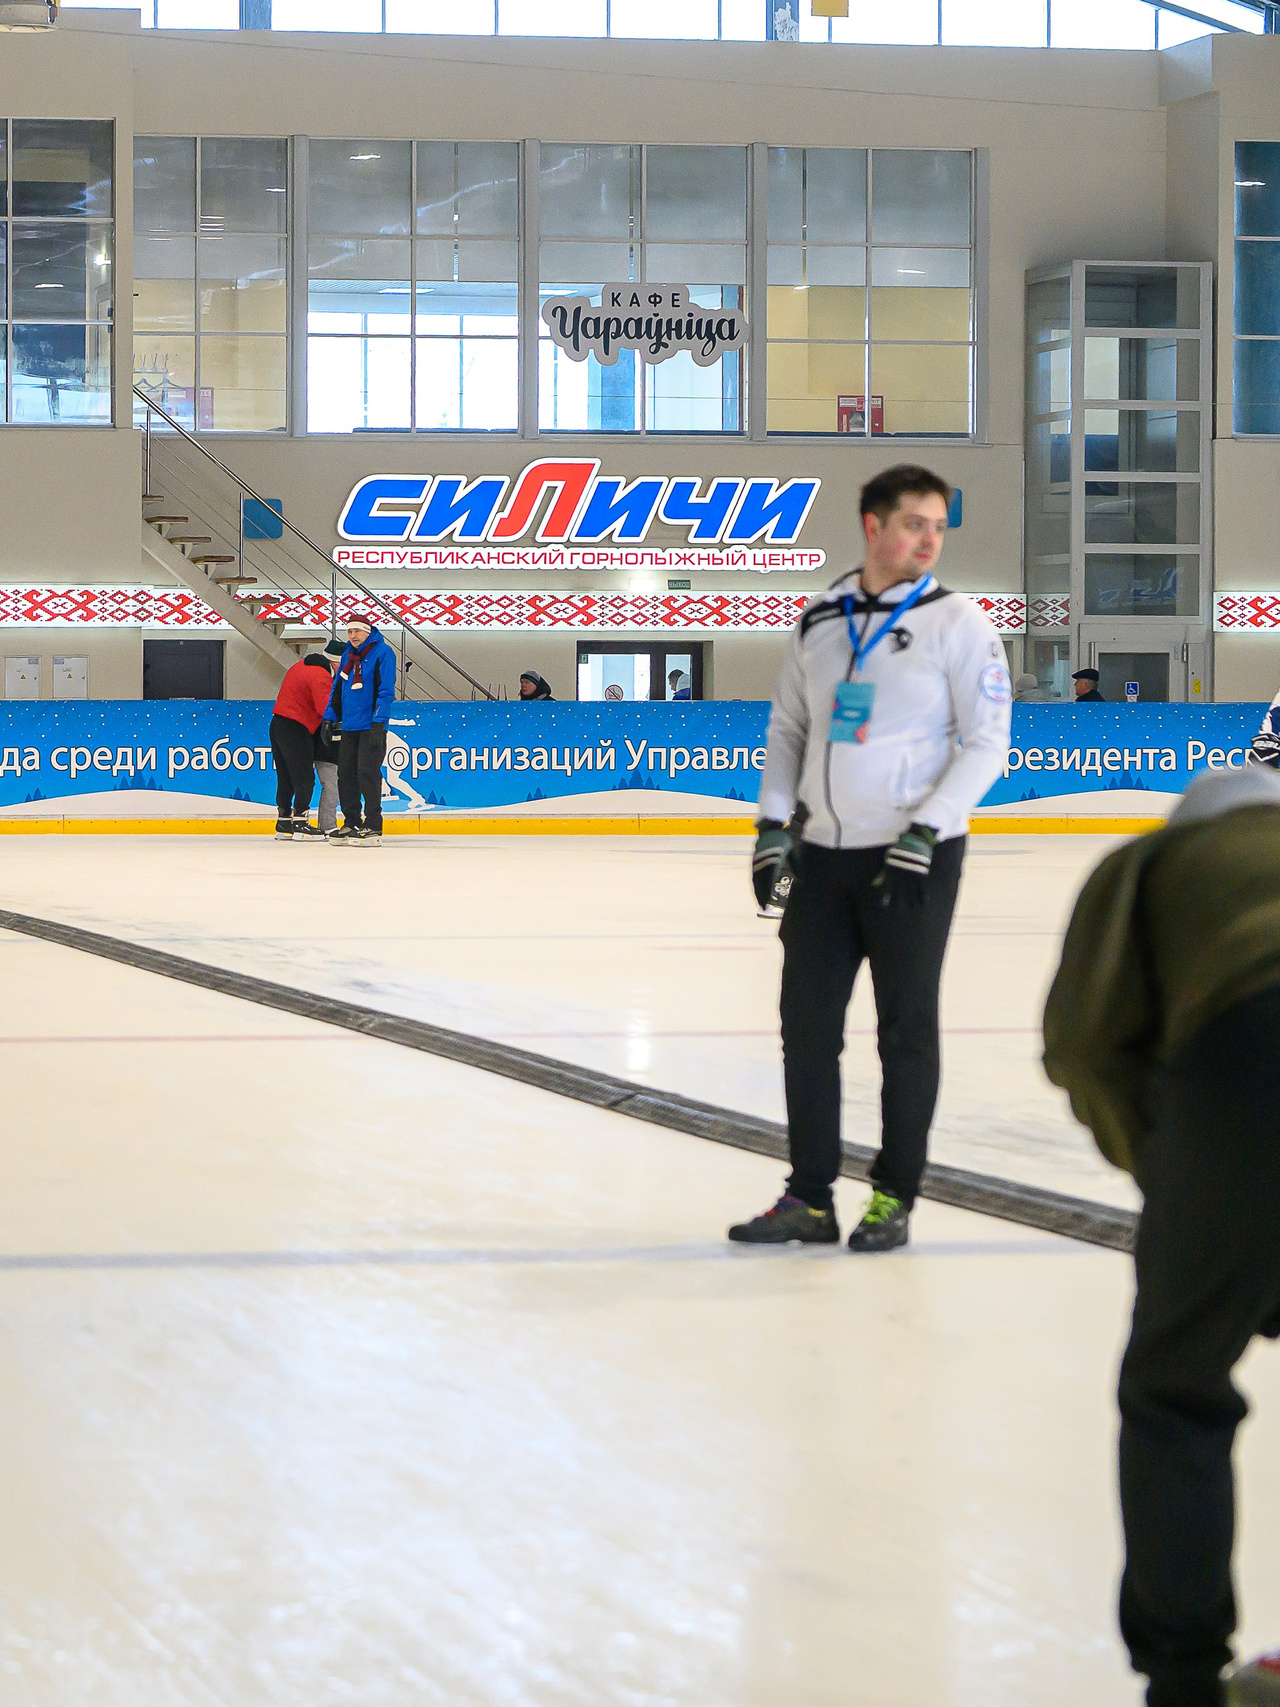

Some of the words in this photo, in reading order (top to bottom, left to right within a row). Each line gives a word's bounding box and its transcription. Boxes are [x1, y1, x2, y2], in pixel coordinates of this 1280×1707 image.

[611, 292, 681, 307] КАФЕ
[552, 306, 740, 357] Чараўніца
[337, 548, 564, 566] РЕСПУБЛИКАНСКИЙ
[570, 549, 747, 566] ГОРНОЛЫЖНЫЙ
[752, 552, 821, 568] ЦЕНТР
[50, 746, 158, 779] среди
[167, 737, 276, 779] работ
[387, 739, 616, 779] организаций
[624, 739, 768, 779] Управле
[1002, 746, 1177, 779] резидента
